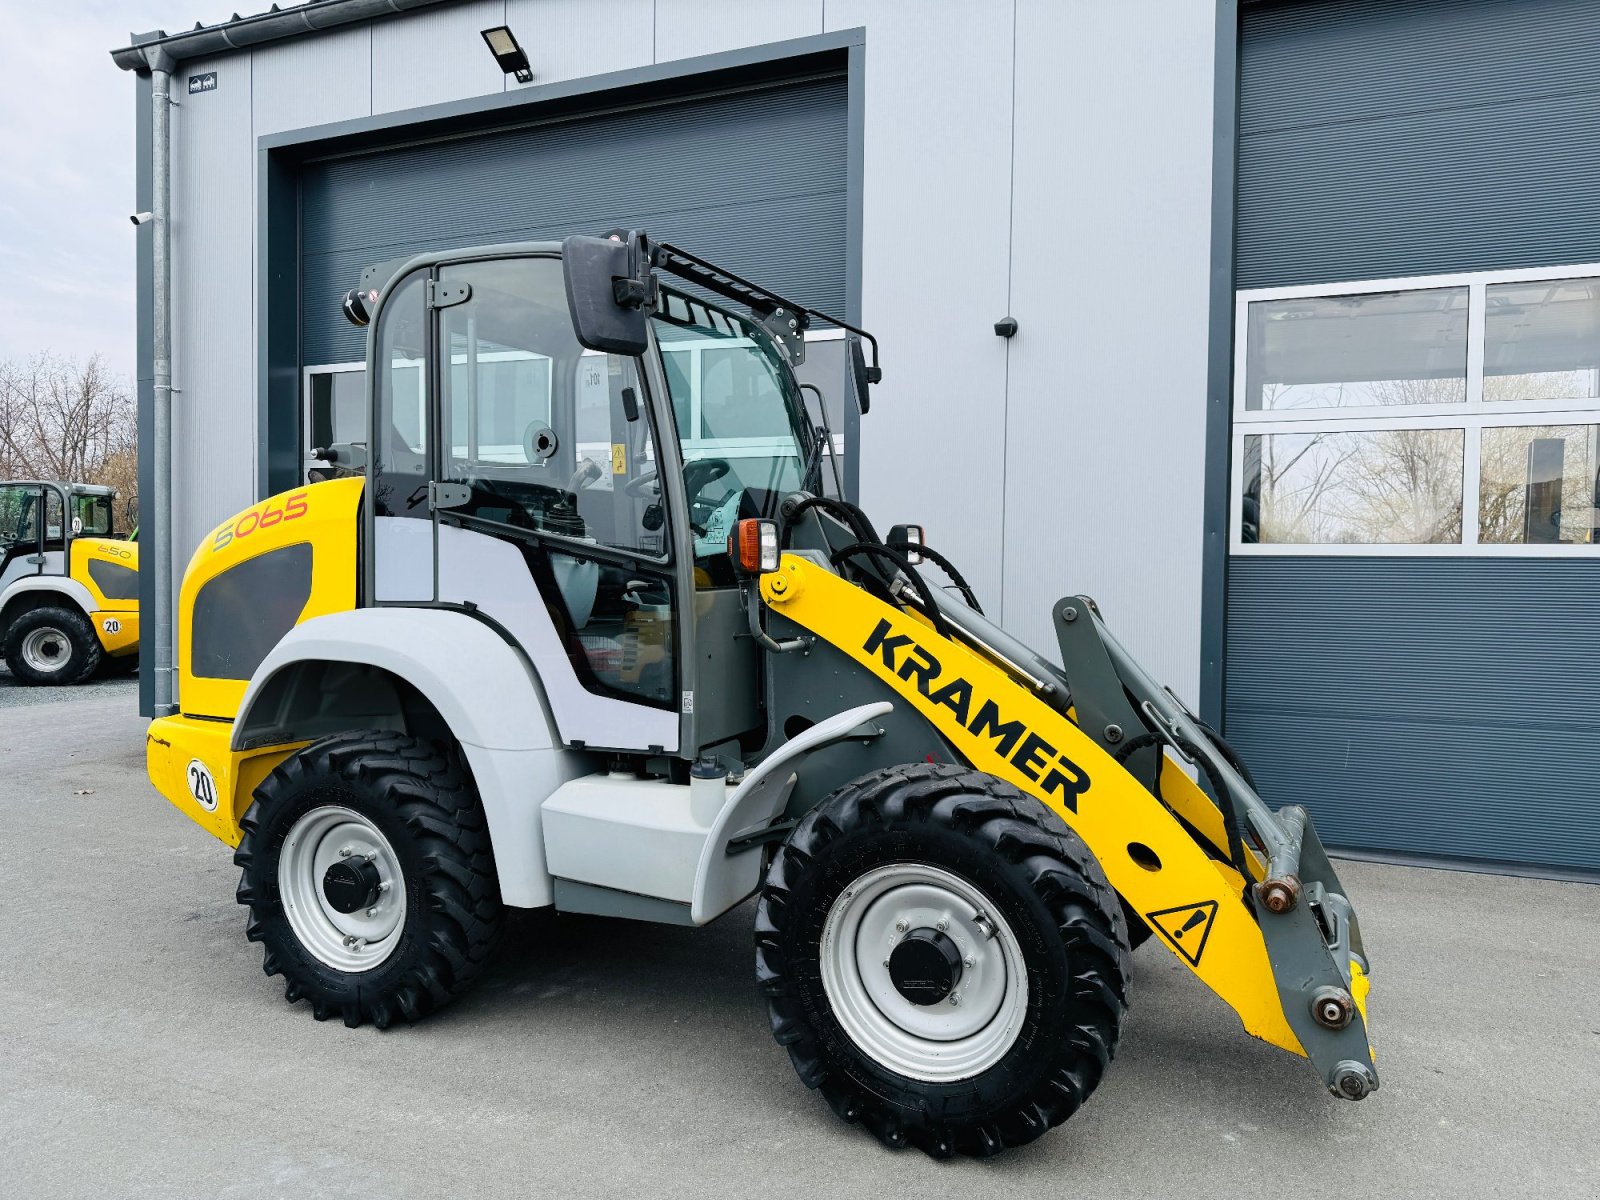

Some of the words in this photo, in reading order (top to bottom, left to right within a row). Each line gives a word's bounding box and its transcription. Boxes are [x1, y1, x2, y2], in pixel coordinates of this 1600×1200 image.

[213, 493, 308, 552] 5065
[97, 544, 131, 559] 650
[105, 621, 119, 633] 20
[863, 618, 1091, 815] KRAMER
[191, 767, 213, 804] 20
